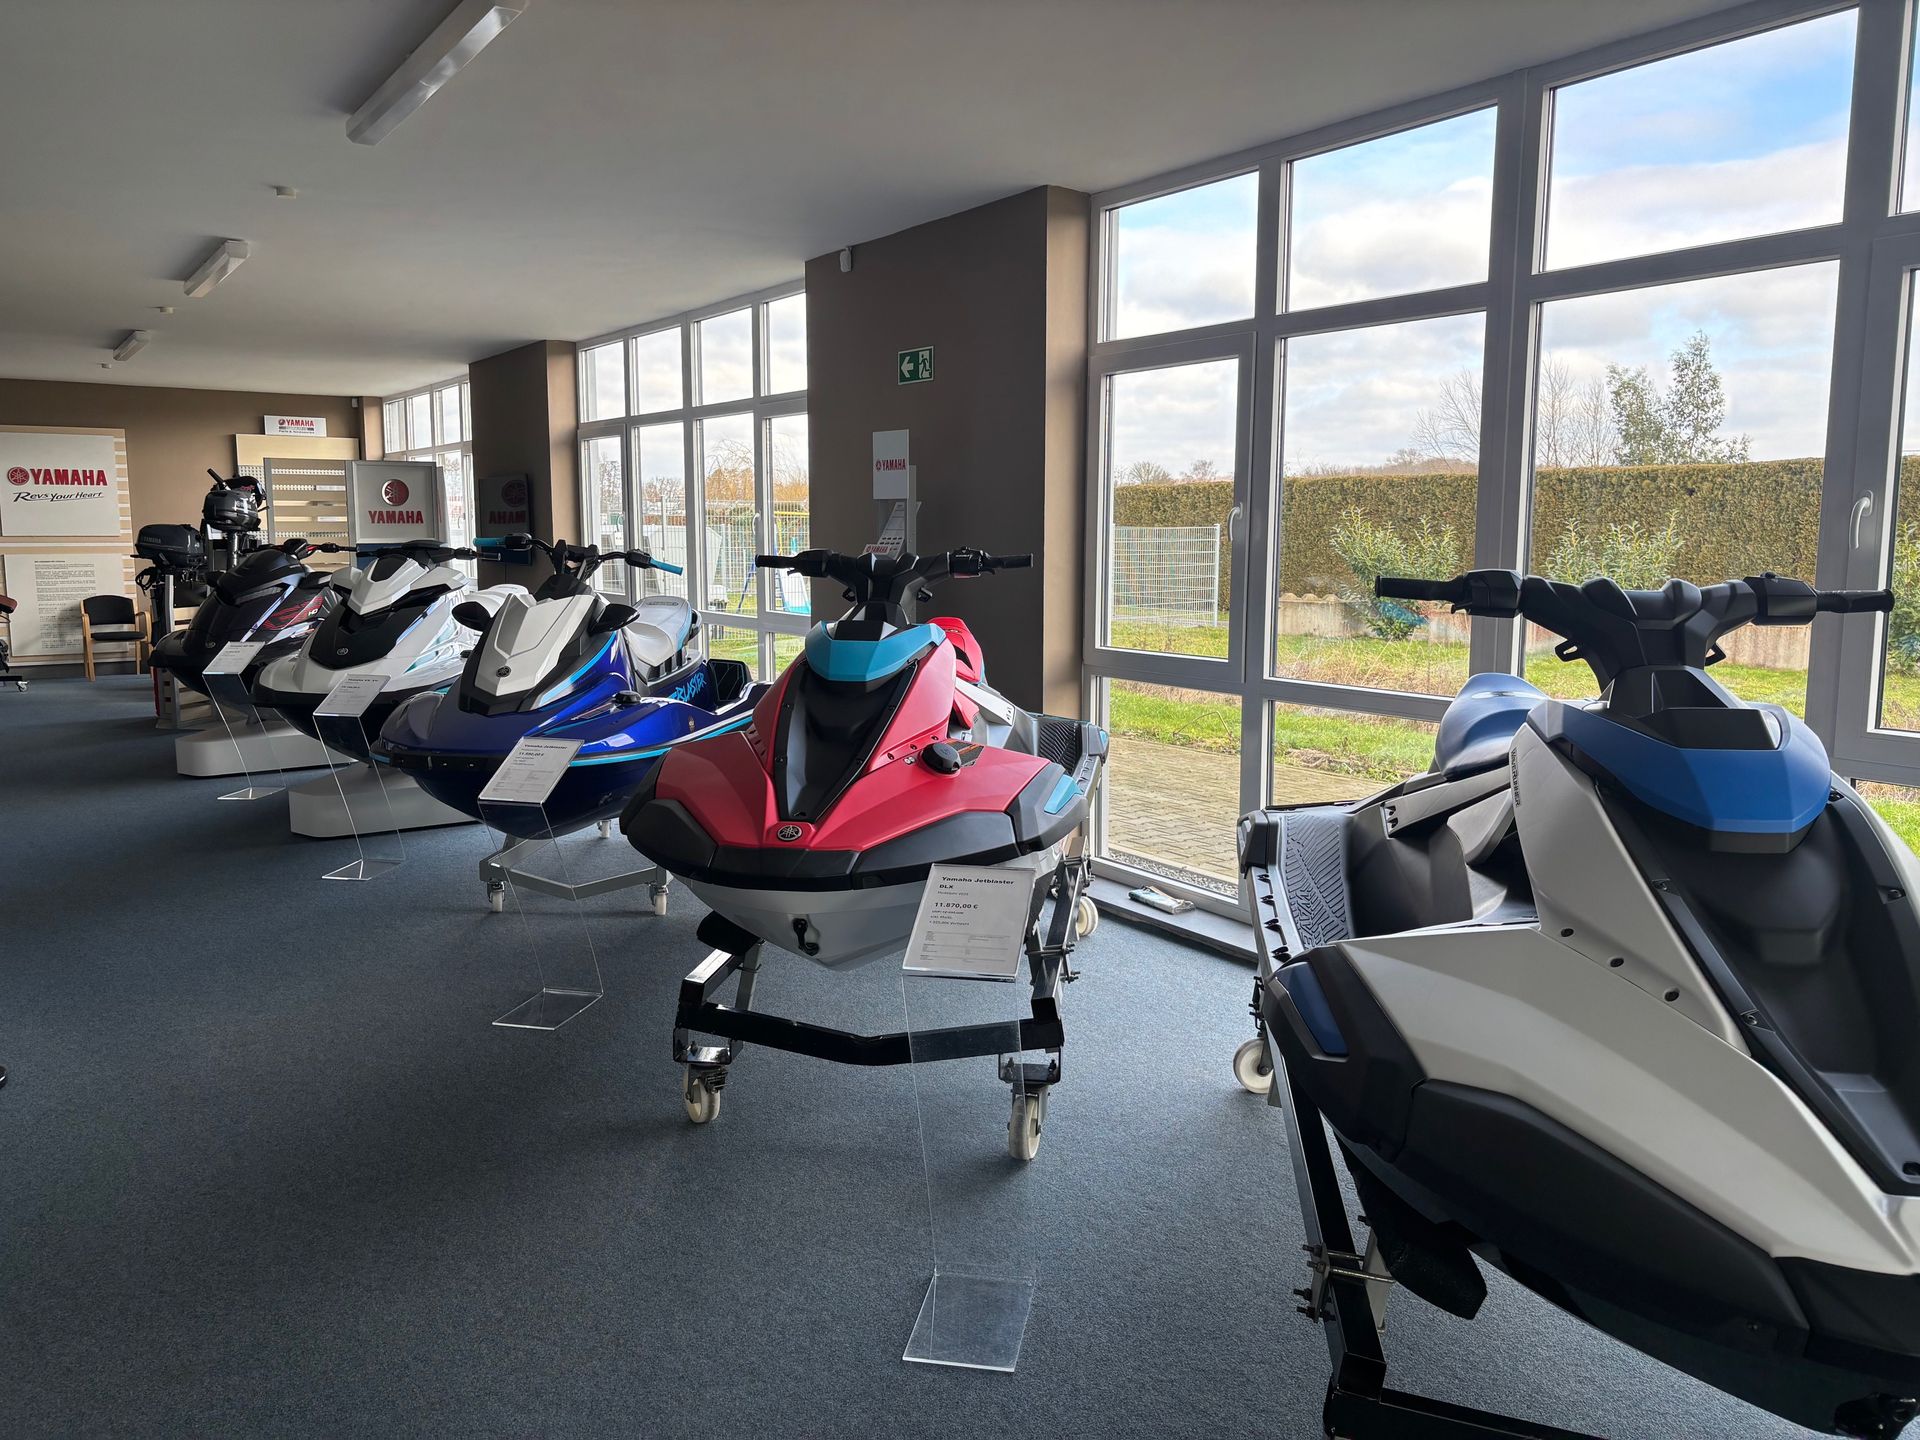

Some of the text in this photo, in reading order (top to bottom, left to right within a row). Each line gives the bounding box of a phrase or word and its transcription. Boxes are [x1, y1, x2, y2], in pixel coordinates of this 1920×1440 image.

[286, 419, 315, 427] YAMAHA
[882, 459, 907, 471] YAMAHA
[30, 468, 108, 486] YAMAHA
[13, 491, 49, 502] Revs
[75, 491, 104, 500] Heart
[368, 510, 424, 524] YAMAHA
